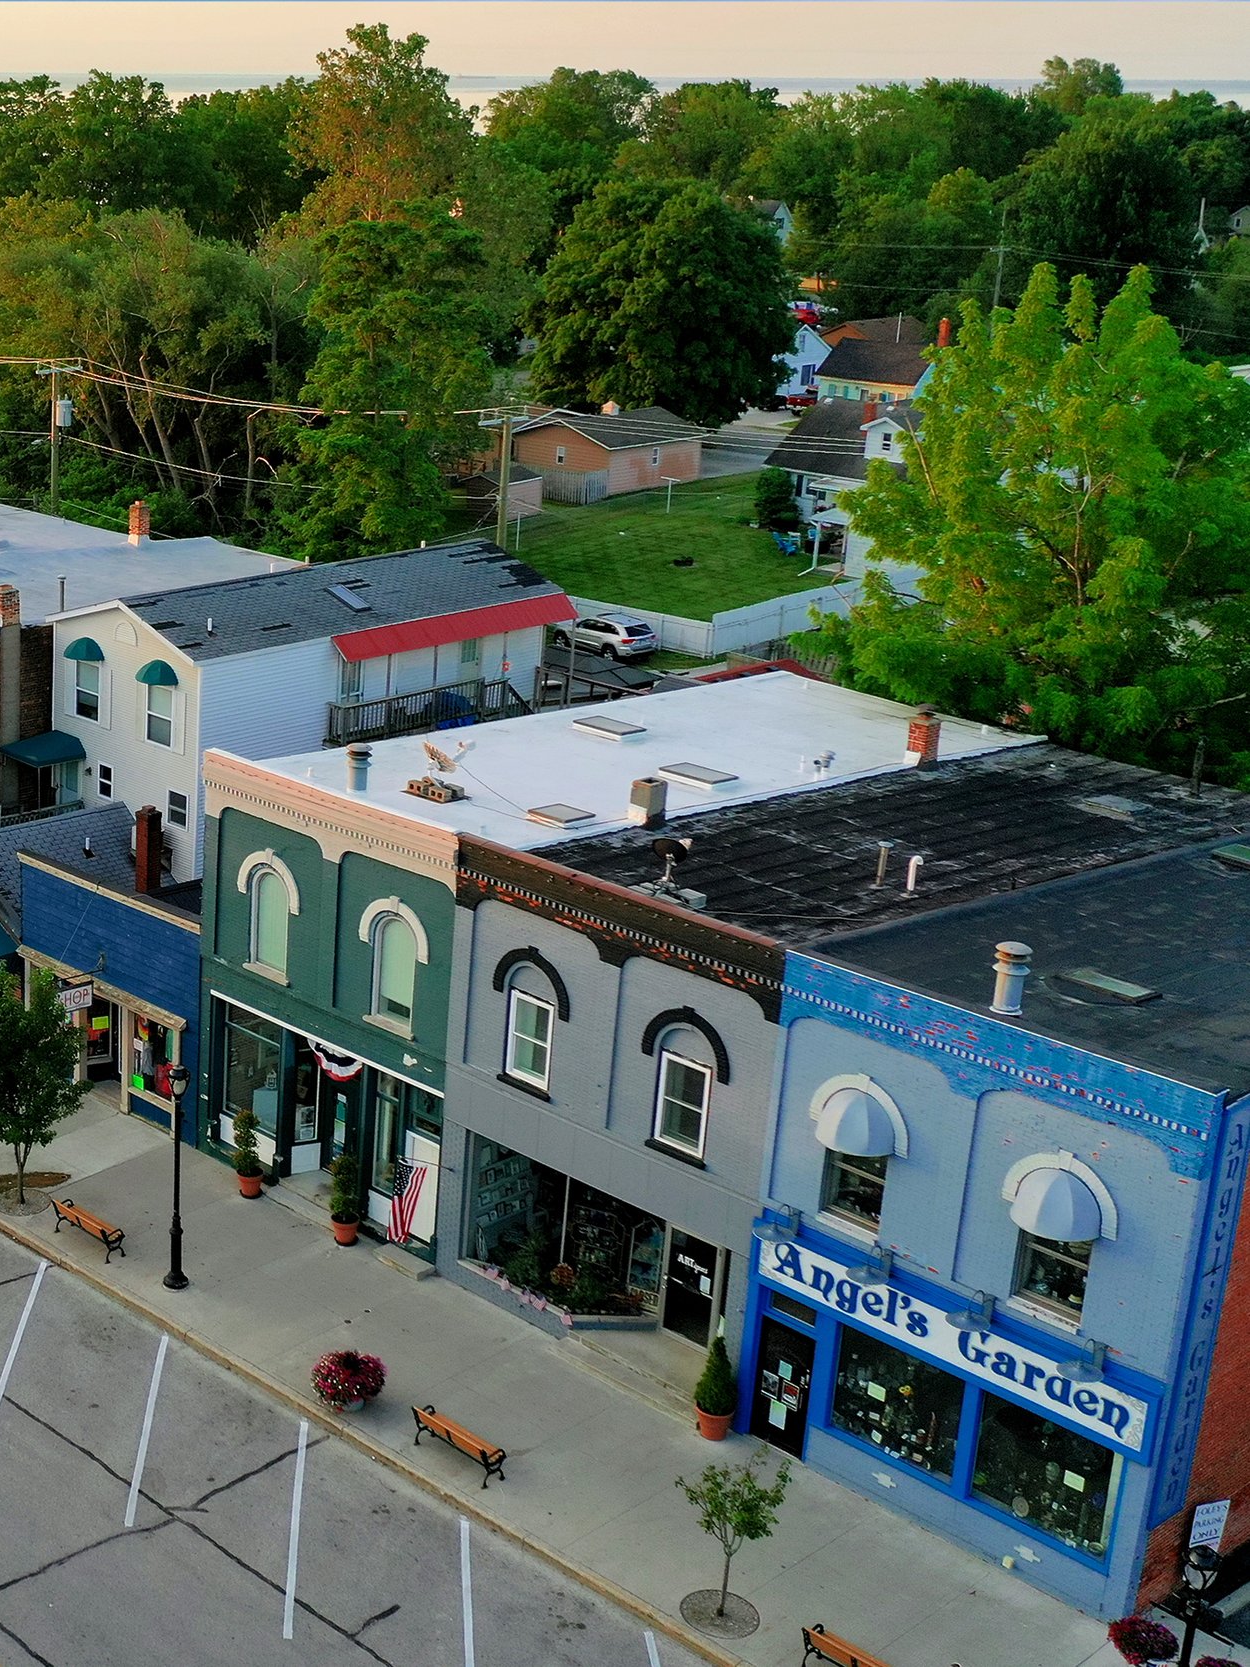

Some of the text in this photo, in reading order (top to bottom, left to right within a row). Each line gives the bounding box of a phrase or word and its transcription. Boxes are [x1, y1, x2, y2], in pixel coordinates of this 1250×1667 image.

[62, 988, 89, 1007] HOP
[773, 1242, 1130, 1439] Angel's Garden
[1166, 1340, 1206, 1501] Garden
[1192, 1528, 1218, 1541] ONLY
